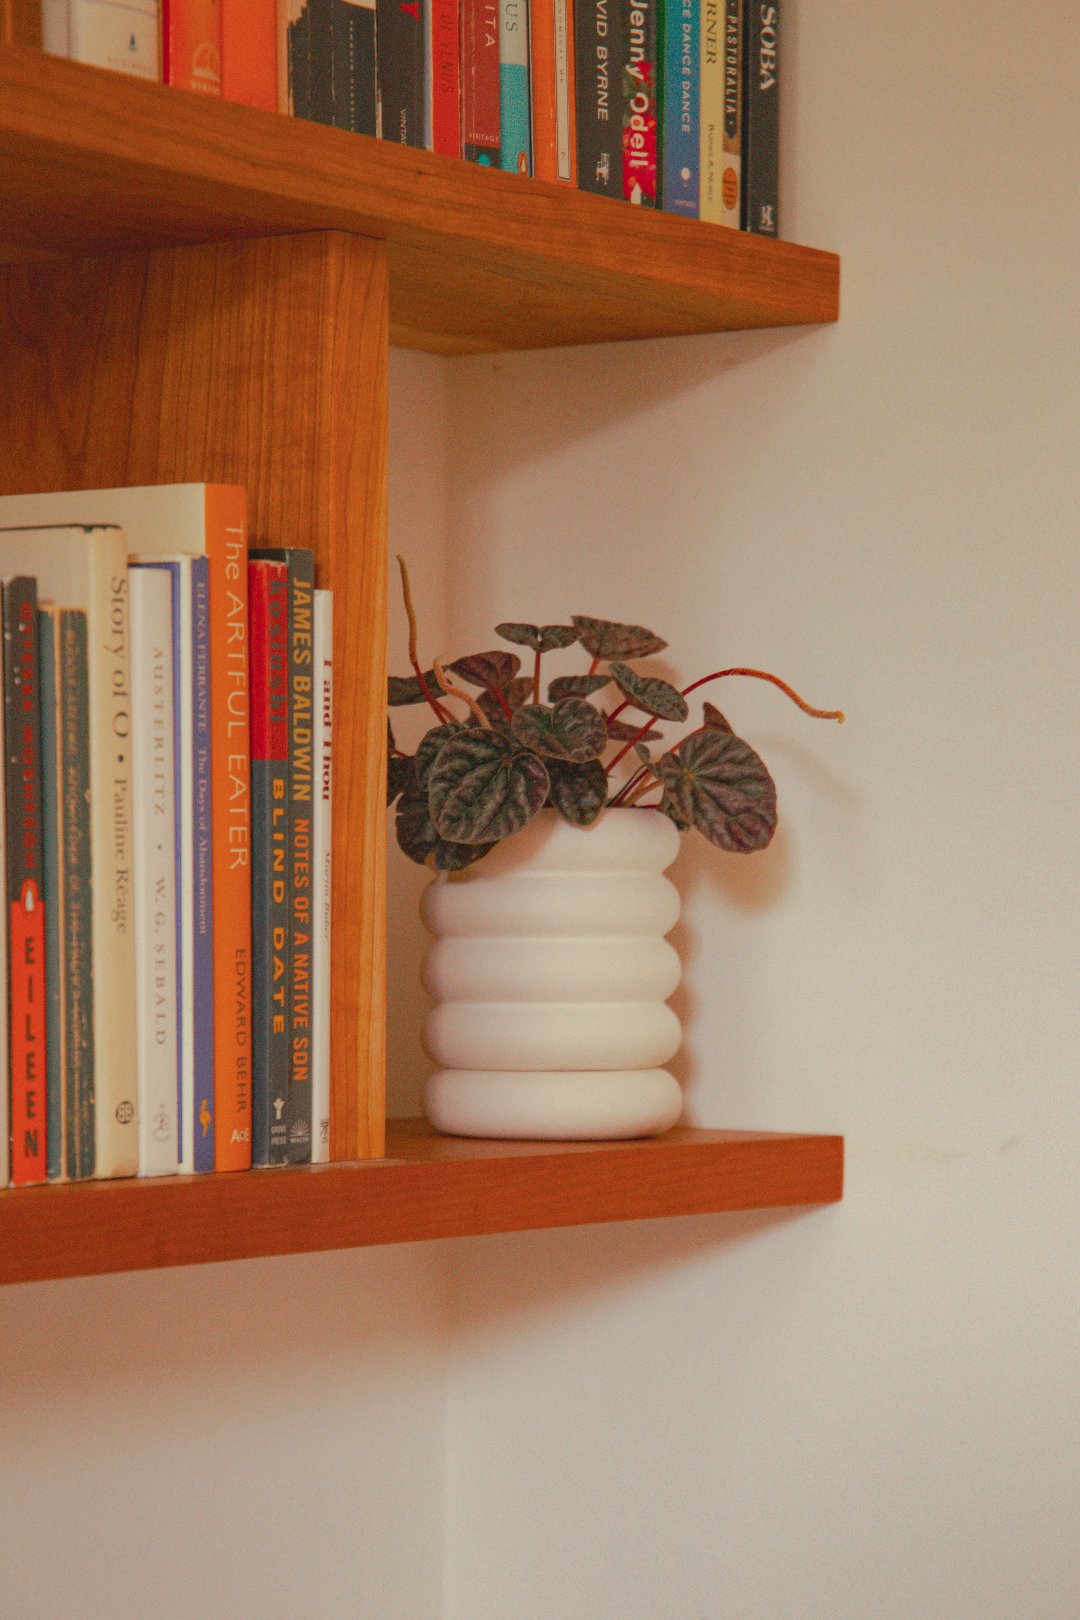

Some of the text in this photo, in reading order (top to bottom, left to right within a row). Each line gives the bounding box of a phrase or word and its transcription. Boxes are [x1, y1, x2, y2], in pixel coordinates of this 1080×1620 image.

[485, 4, 497, 48] ITA
[505, 3, 518, 32] US
[681, 23, 692, 76] DANCE
[706, 1, 718, 65] RNER
[759, 4, 777, 90] SOBA
[596, 45, 608, 122] BYRNE
[626, 0, 649, 167] Jenny Odell
[726, 14, 738, 114] PASTORALIA
[681, 80, 691, 135] DANCE
[104, 575, 127, 652] Story
[112, 669, 129, 698] of
[323, 679, 332, 727] and
[111, 711, 128, 738] O
[197, 581, 209, 936] ELENA FERRANTE The Days of Abandonment
[269, 579, 287, 1034] kosinski BLIND DATE
[322, 737, 332, 801] Thou
[114, 778, 130, 861] Pauline
[153, 646, 166, 1045] AUSTERLITZ W. G. SEBALD
[225, 520, 249, 1113] The ARTFUL EATER EDWARD BEHR
[292, 576, 312, 1082] JAMES BALDWIN NOTES OF A NATIVE SON
[323, 901, 331, 941] Buber
[24, 937, 39, 1159] EILEEN
